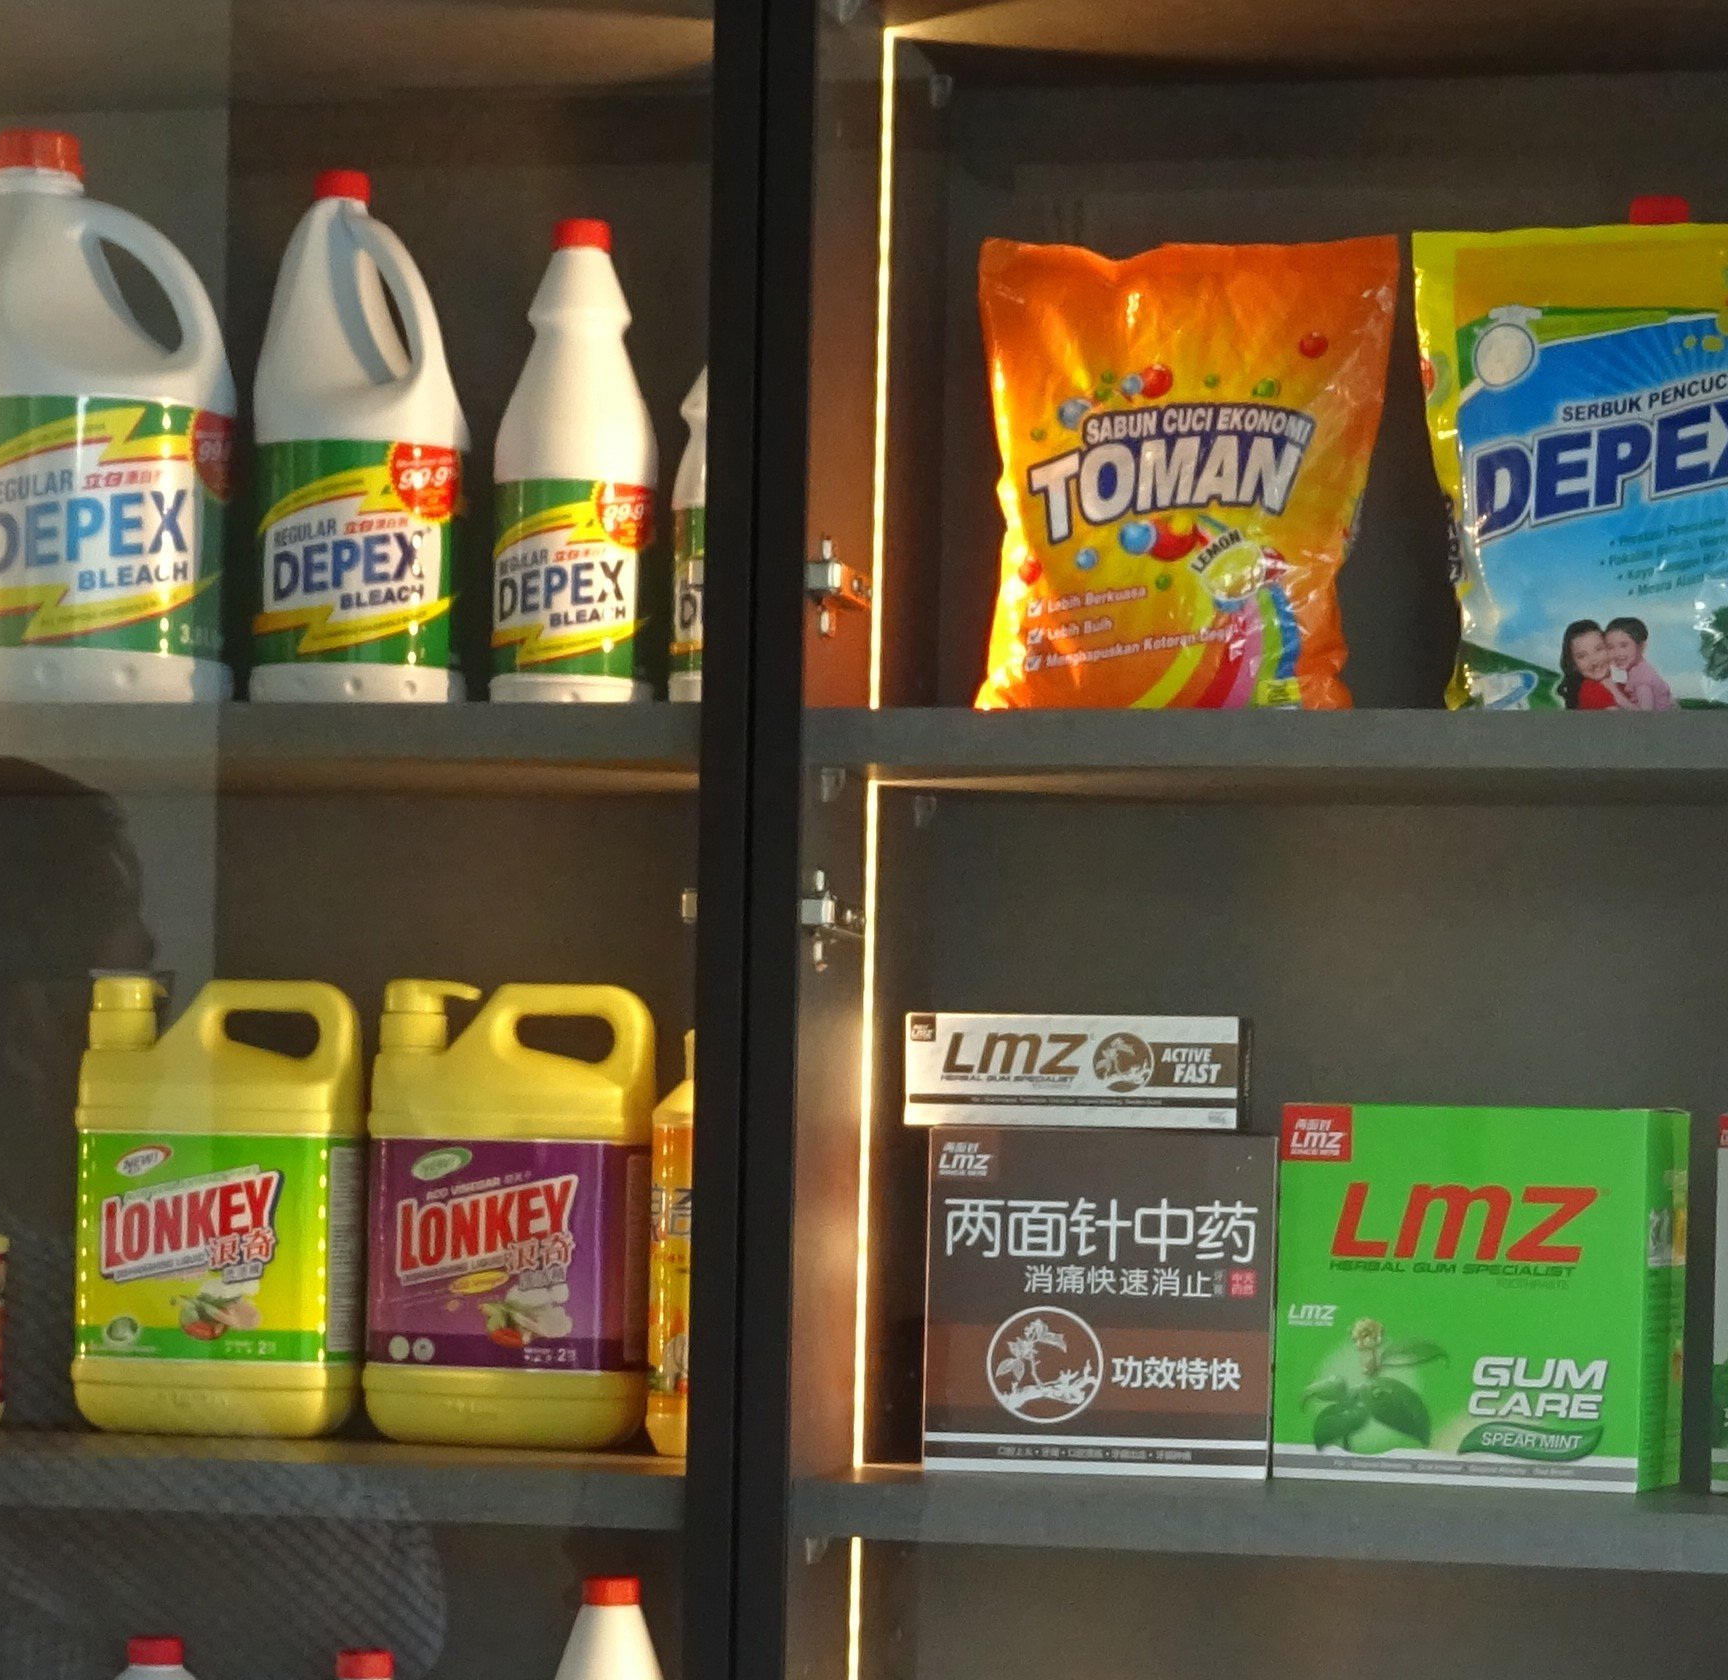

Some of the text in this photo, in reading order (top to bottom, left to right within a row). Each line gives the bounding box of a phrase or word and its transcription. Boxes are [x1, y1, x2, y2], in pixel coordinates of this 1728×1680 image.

[1085, 406, 1312, 444] SABUN CUCI EKONOMI
[1561, 395, 1642, 423] SERBUK
[1030, 434, 1303, 542] TOMAN
[274, 518, 337, 546] REGULAR
[273, 531, 425, 601] DEPEX
[1191, 528, 1242, 575] LEMON
[78, 561, 188, 592] BLEACH
[499, 560, 625, 623] DEPEX
[340, 585, 425, 610] BLEACH
[1160, 1047, 1213, 1064] ACTIVE
[1173, 1062, 1223, 1085] FAST
[104, 1175, 274, 1270] LONKEY
[400, 1179, 574, 1272] LONKEY
[944, 1197, 1259, 1263] 两面针中药
[209, 1227, 276, 1266] 浪奇
[1023, 1263, 1213, 1299] 消痛快速消止
[1329, 1260, 1577, 1278] HERBAL GUM SPECIALIST
[1110, 1355, 1242, 1391] 功效特快
[1472, 1356, 1609, 1391] GUM
[1467, 1391, 1603, 1421] CARE
[1480, 1431, 1583, 1451] SPEAR MINT
